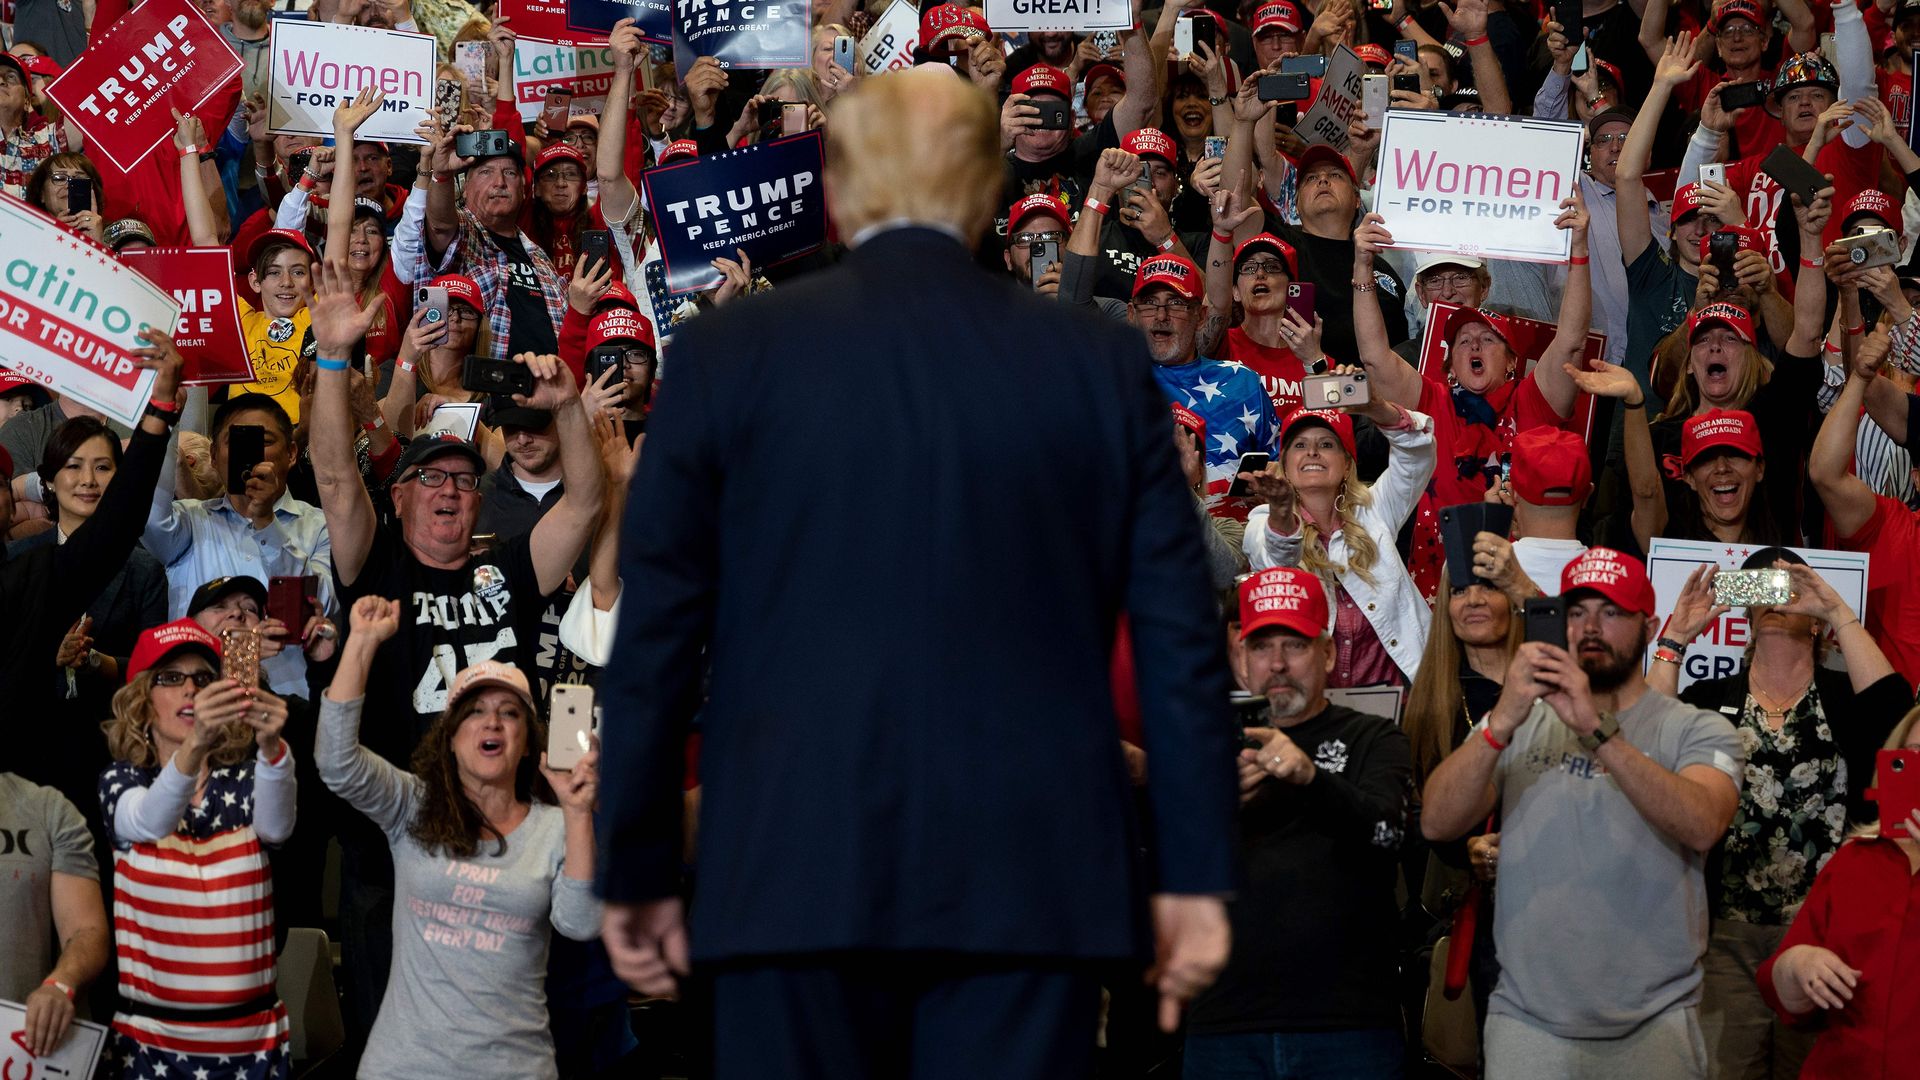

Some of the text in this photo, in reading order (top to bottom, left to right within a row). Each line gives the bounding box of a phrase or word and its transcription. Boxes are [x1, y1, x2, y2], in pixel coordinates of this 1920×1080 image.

[526, 5, 566, 14] KEEP AMER
[1012, 0, 1101, 14] GREAT!
[1258, 7, 1292, 19] TRUMP
[683, 5, 781, 34] PENCE
[929, 6, 975, 30] USA
[702, 24, 736, 36] AMERICA
[738, 24, 770, 32] GREAT!
[865, 33, 895, 72] EEP
[78, 14, 190, 117] TRUMP
[514, 47, 614, 76] Latino
[283, 49, 423, 97] Women
[1025, 74, 1056, 83] AMERICA
[104, 43, 196, 124] PENCE
[569, 77, 614, 96] TRU
[125, 107, 143, 126] KEEP
[142, 82, 173, 111] AMERICA
[171, 60, 196, 85] GREAT!
[296, 92, 410, 113] FOR TMP
[571, 107, 597, 116] 2020
[1139, 127, 1163, 137] KEEP
[1130, 134, 1170, 149] AMERICA
[1136, 142, 1166, 153] GREAT
[1394, 148, 1561, 201] Women
[666, 171, 813, 224] TRUMP
[1859, 189, 1883, 197] KEEP
[1406, 197, 1542, 220] FOR TRUMP
[1849, 196, 1890, 208] AMERICA
[1853, 202, 1883, 212] GREAT
[687, 199, 804, 241] PENCE
[702, 220, 796, 250] KEEP AMERICA GREAT!
[1458, 243, 1479, 251] 2020
[1142, 261, 1189, 278] TRUMP
[437, 280, 472, 291] Trump
[5, 258, 152, 347] atinos
[607, 308, 633, 319] KEEP
[596, 317, 643, 331] AMERICA
[603, 327, 636, 338] GREAT
[0, 305, 134, 377] OR TRUMP
[176, 338, 206, 347] GREAT!
[15, 361, 53, 385] 2020
[1692, 418, 1744, 434] MAKE AMERICA
[1695, 426, 1742, 440] GREAT AGAIN
[1582, 548, 1618, 561] KEEP
[1568, 560, 1628, 578] AMERICA
[1260, 571, 1295, 586] KEEP
[1572, 572, 1619, 585] GREAT
[1248, 583, 1309, 603] AMERICA
[1254, 598, 1301, 612] GREAT
[153, 630, 180, 640] MAKE
[159, 634, 187, 644] GREAT
[446, 860, 501, 884] I PRAY
[452, 884, 486, 904] FOR
[423, 922, 506, 953] EVERY DAY
